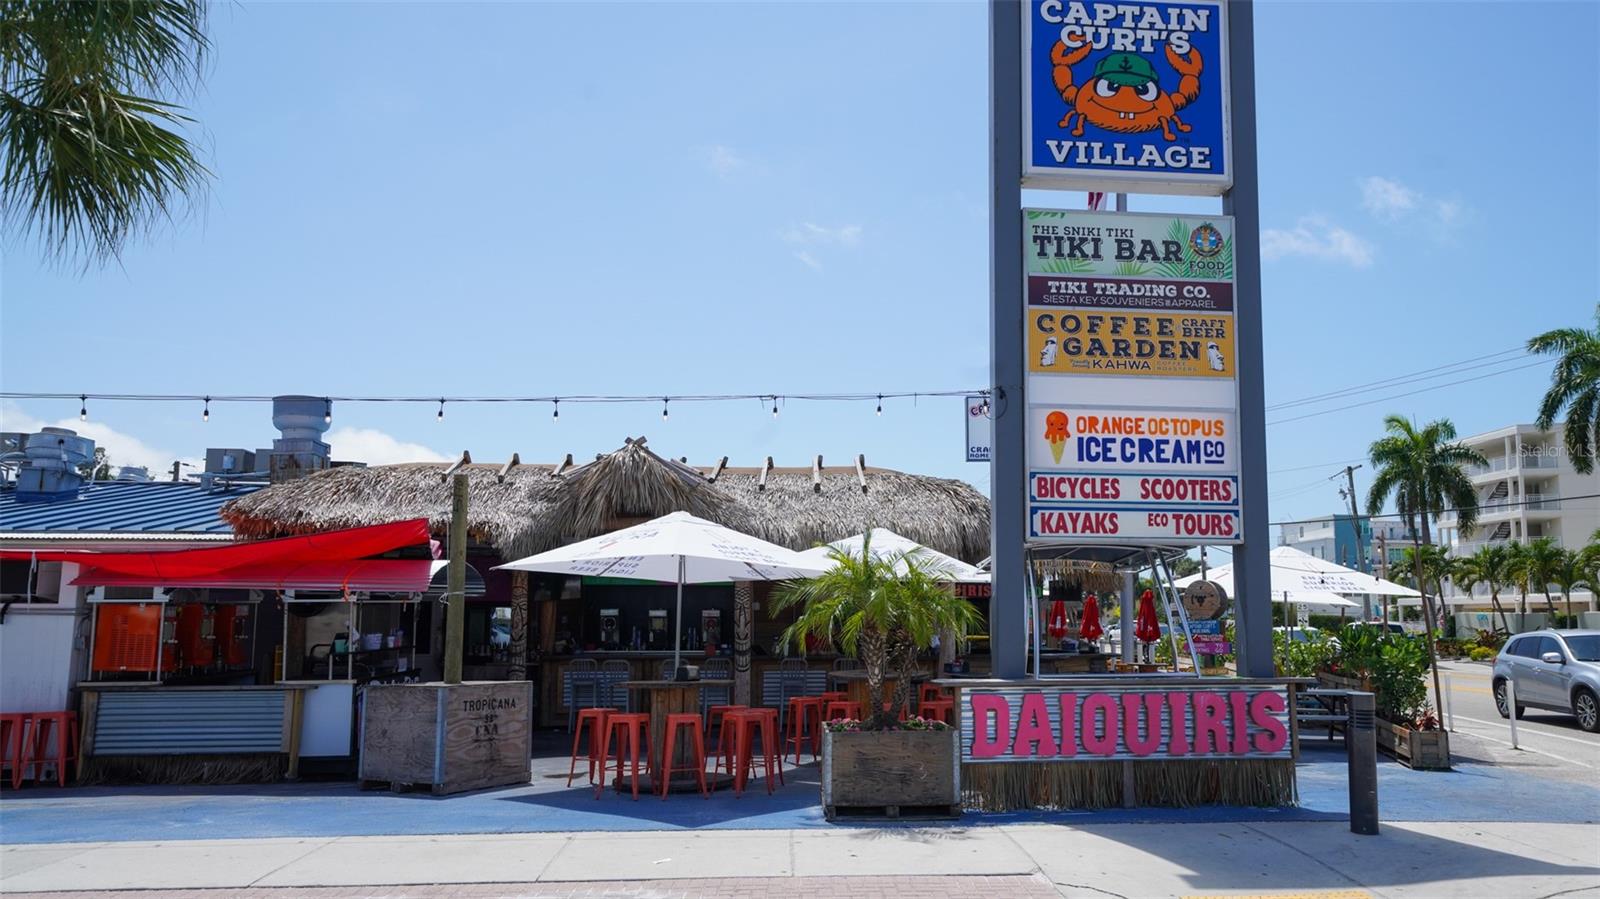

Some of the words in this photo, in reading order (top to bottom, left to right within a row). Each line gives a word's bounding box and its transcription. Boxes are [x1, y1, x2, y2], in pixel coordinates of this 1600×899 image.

[1040, 0, 1210, 32] CAPTAIN
[1060, 25, 1191, 54] CURT'S
[1046, 140, 1211, 169] VILLAGE
[1032, 225, 1058, 234] THE
[1064, 226, 1100, 237] SNIKI
[1106, 228, 1134, 238] TIKI
[1032, 236, 1103, 261] TIKI
[1114, 238, 1184, 263] BAR
[1190, 261, 1224, 269] FOOD
[1048, 281, 1087, 294] TIKI
[1094, 282, 1177, 297] TRADING
[1182, 286, 1210, 298] CO.
[1043, 295, 1078, 304] SIESTA
[1080, 296, 1098, 304] KEY
[1100, 296, 1165, 306] SOUVENIERS
[1171, 299, 1216, 308] APPAREL
[1036, 314, 1175, 337] COFFEE
[1182, 318, 1226, 327] CRAFT
[1182, 327, 1226, 338] BEER
[1063, 337, 1200, 360] GARDEN
[1093, 360, 1151, 370] KAHWA
[1076, 416, 1145, 435] ORANGE
[1148, 417, 1224, 437] OCTOPUS
[1077, 436, 1117, 463] ICE
[1120, 438, 1200, 464] CREAM
[1204, 440, 1225, 458] CO
[1036, 476, 1120, 499] BICYCLES
[1140, 478, 1232, 501] SCOOTERS
[1040, 512, 1118, 534] KAYAKS
[1148, 513, 1169, 526] ECO
[1172, 513, 1234, 536] TOURS
[464, 698, 516, 712] TROPICANA
[970, 691, 1288, 758] DAIQUIRIS
